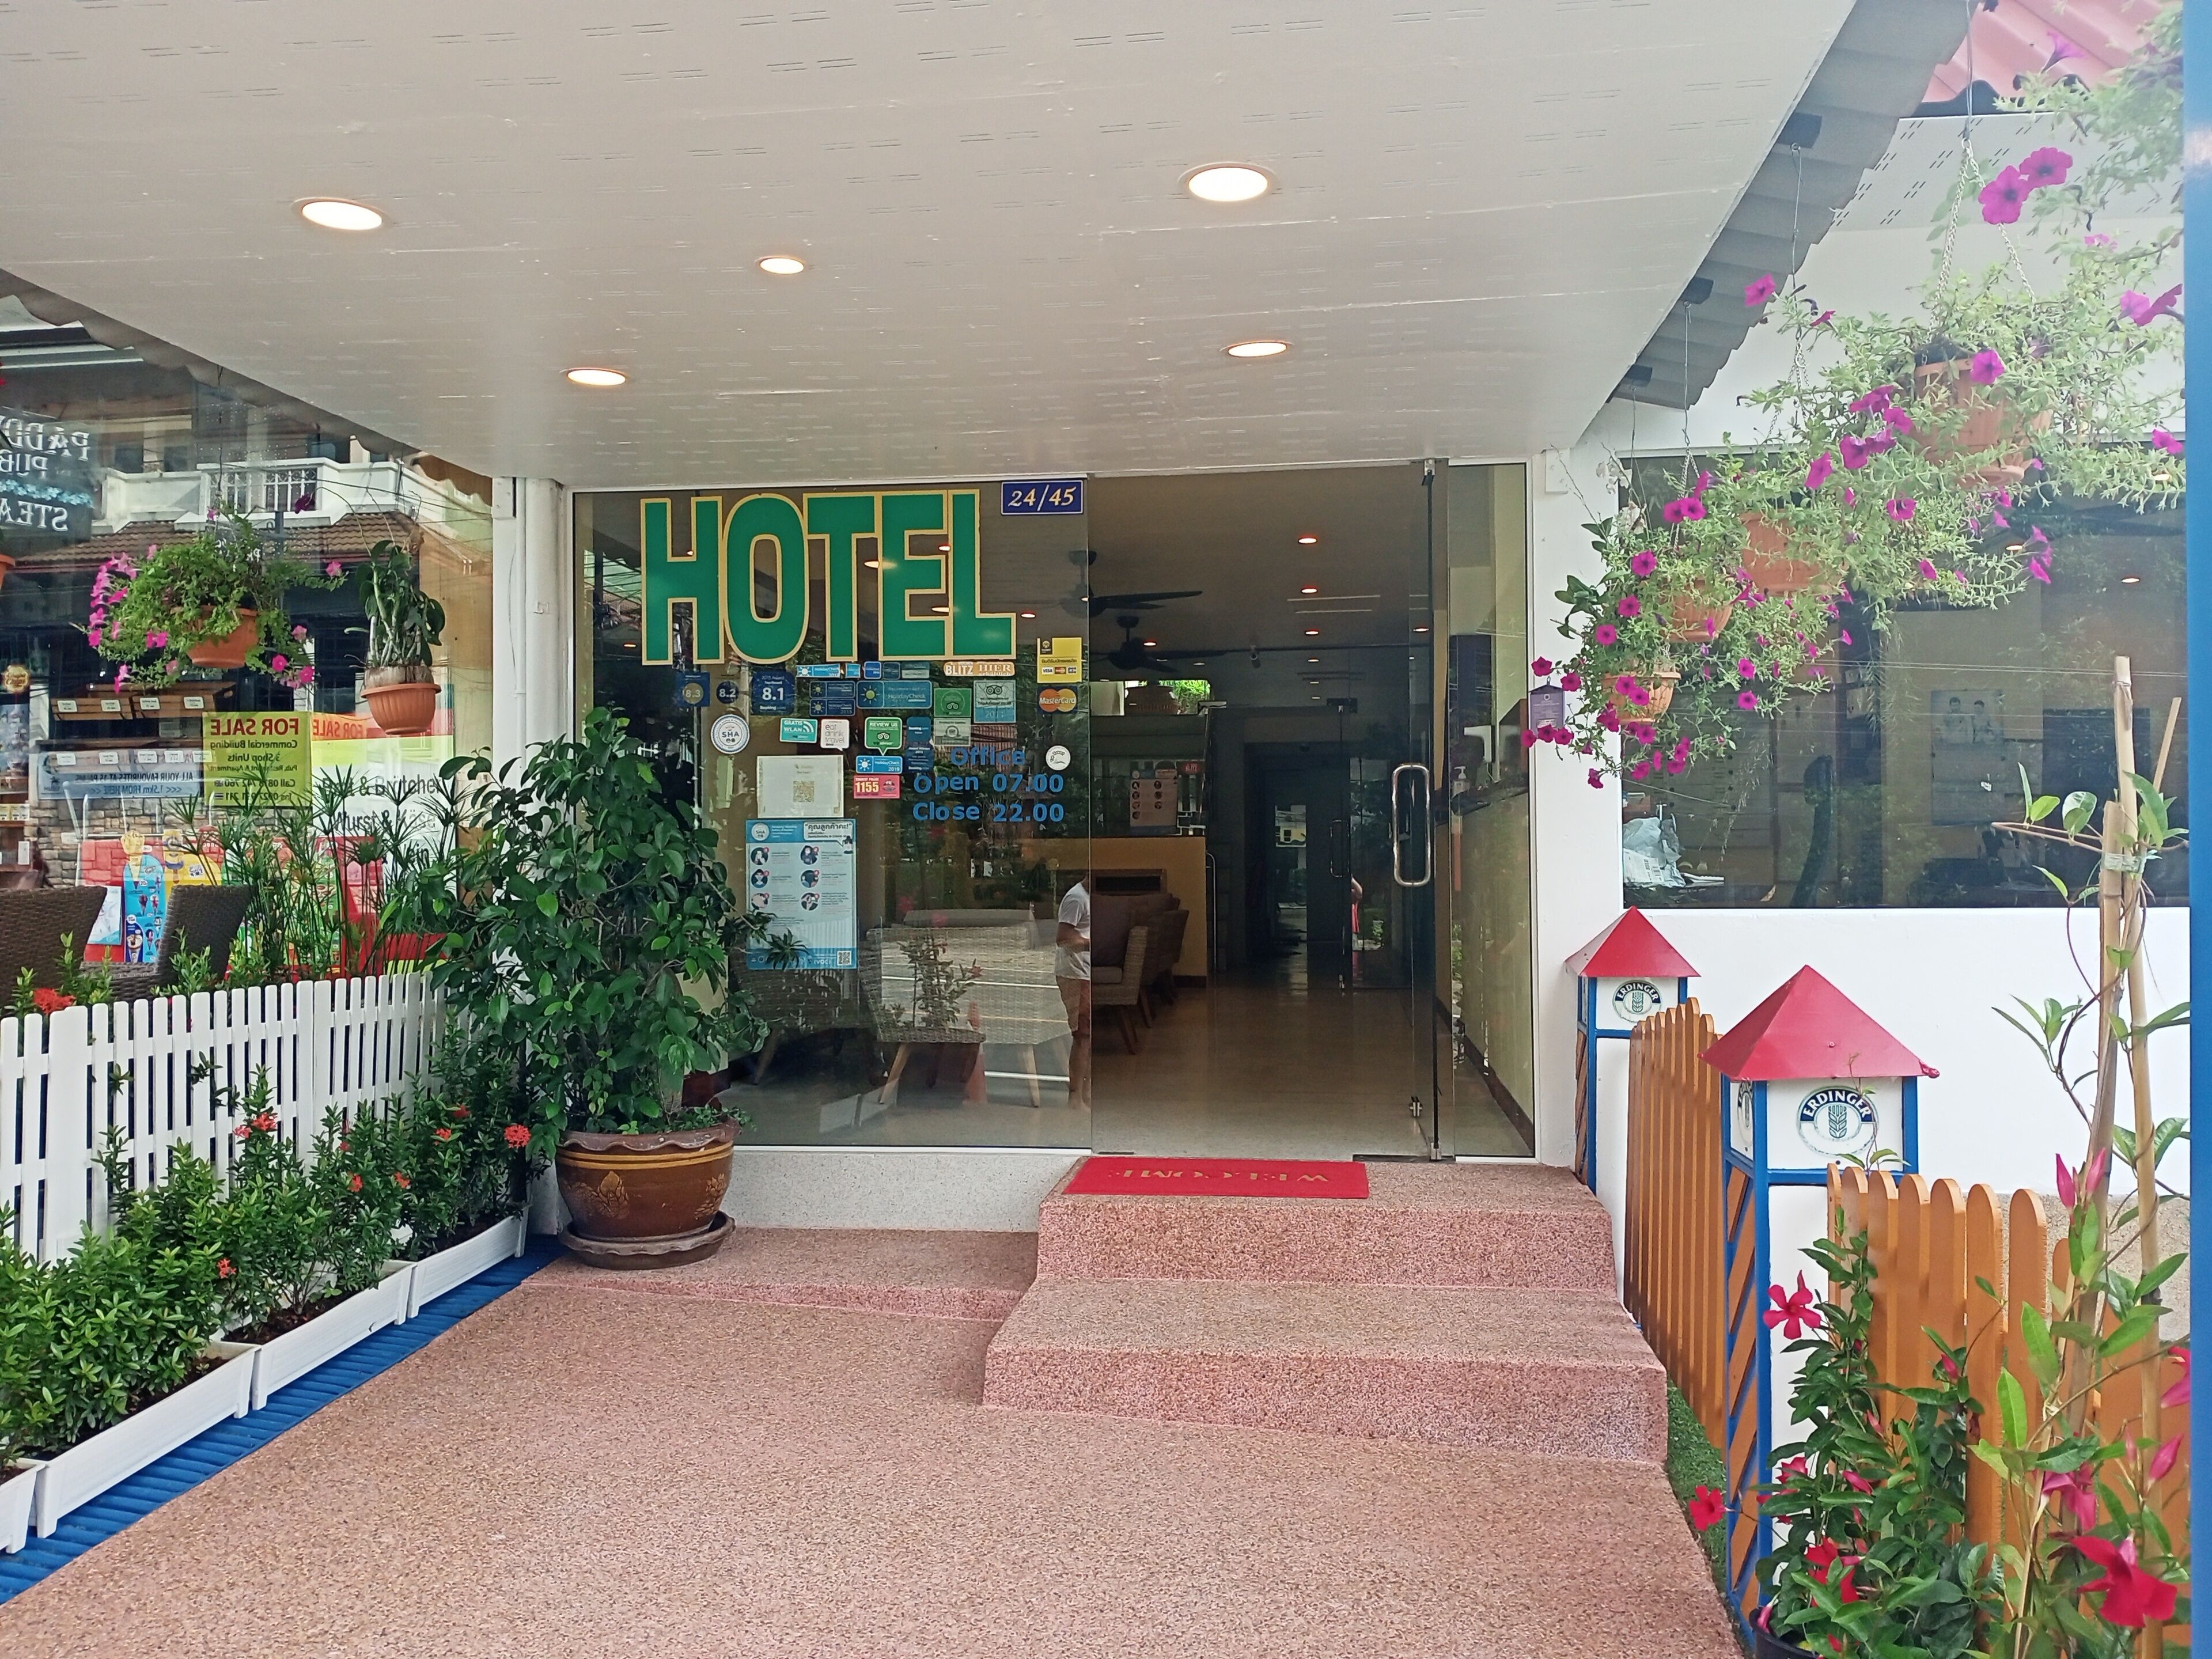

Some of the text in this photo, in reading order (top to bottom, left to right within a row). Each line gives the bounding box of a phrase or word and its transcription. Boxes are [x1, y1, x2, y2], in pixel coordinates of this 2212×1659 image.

[1007, 484, 1077, 511] 24/45
[641, 489, 1016, 665] HOTEL
[945, 665, 974, 675] BLITZ
[685, 690, 701, 698] 8.3
[719, 689, 737, 698] 8.2
[762, 687, 784, 701] 8.1
[950, 747, 1025, 766] Office
[855, 782, 880, 793] 1155
[913, 774, 1064, 795] Open 07.00
[912, 802, 1064, 823] Close 22.00
[1616, 983, 1659, 1001] ERDINGER
[1802, 1090, 1872, 1118] ERDINGER
